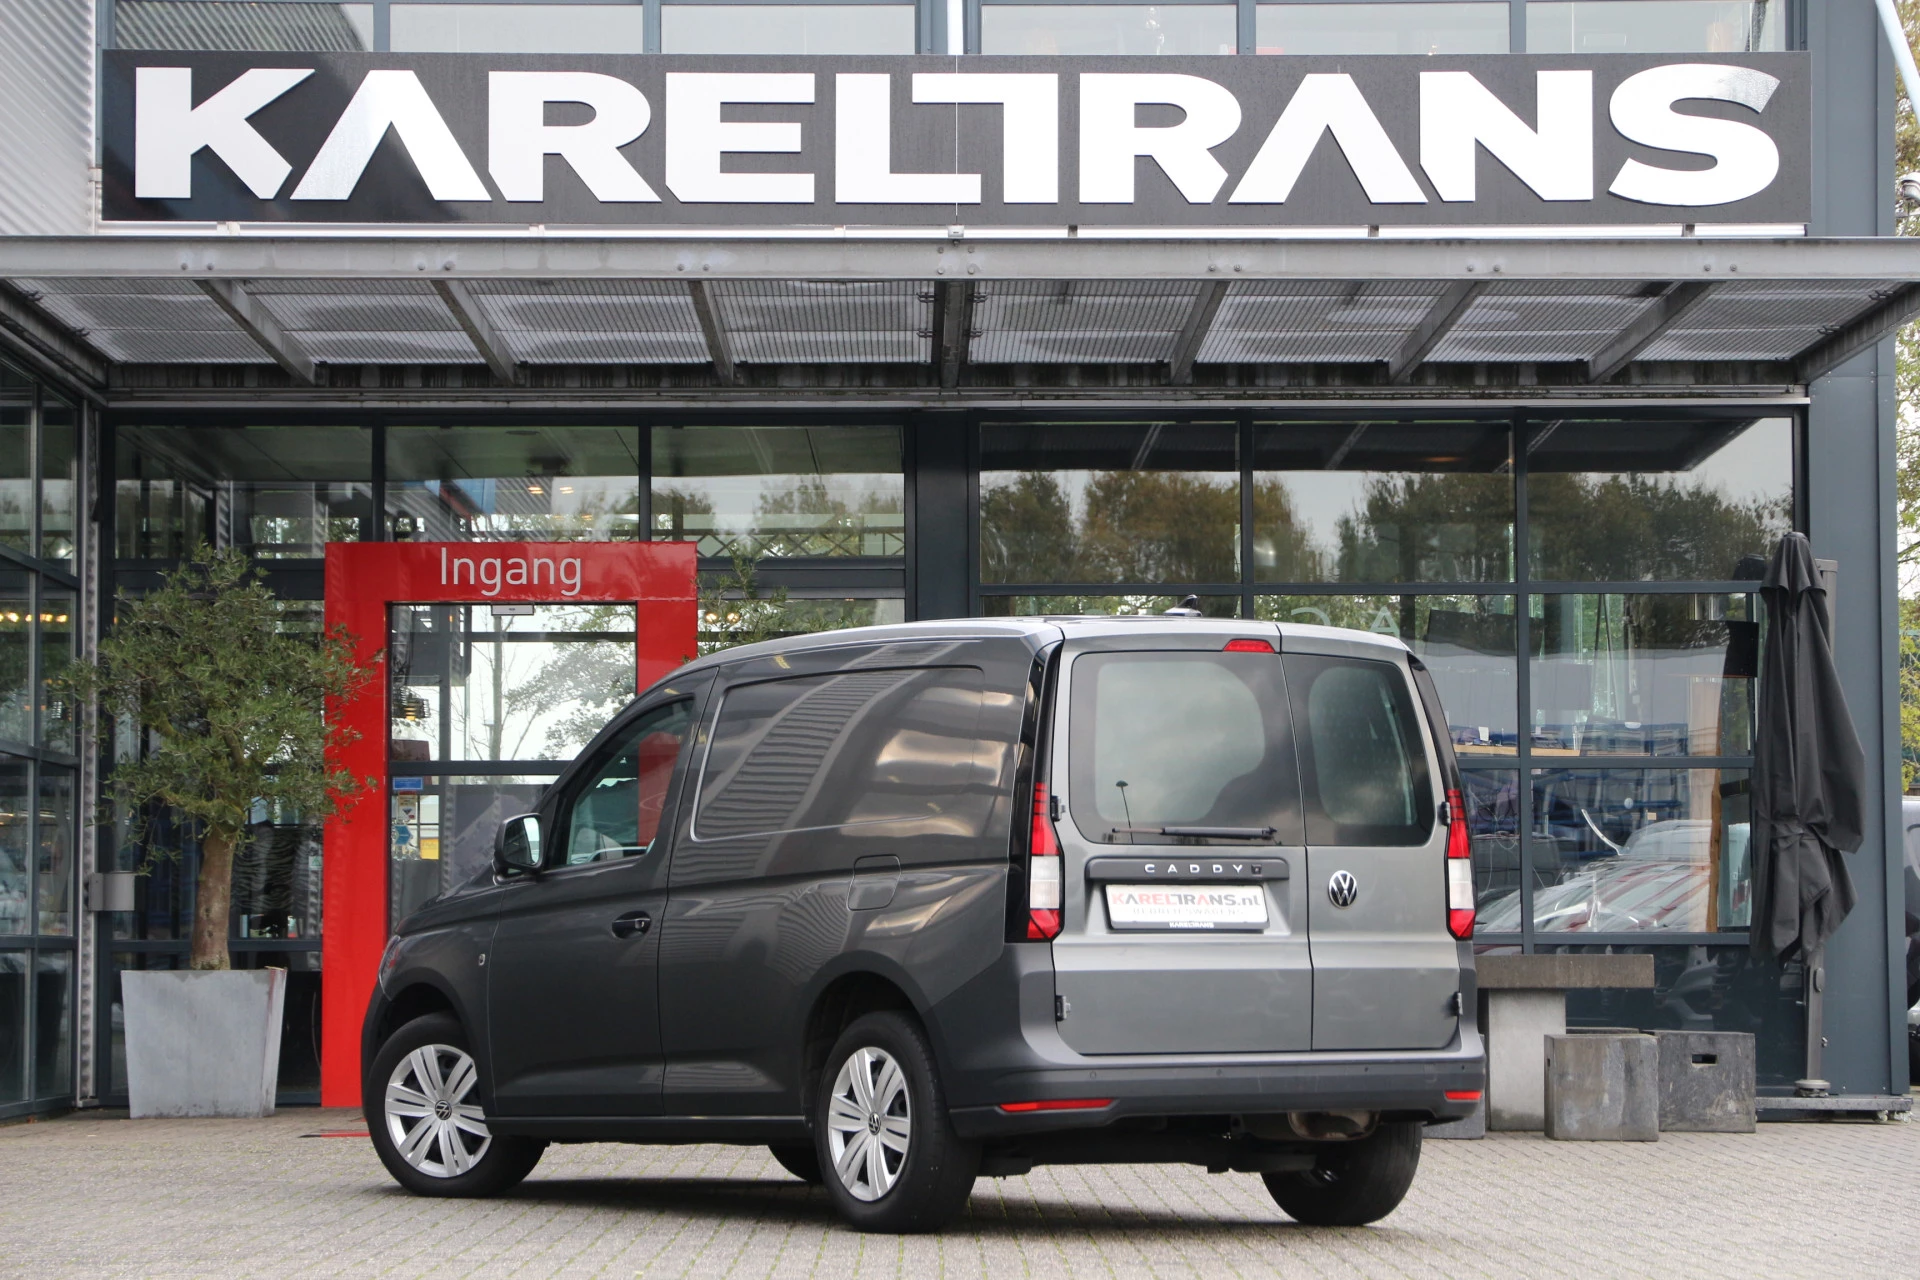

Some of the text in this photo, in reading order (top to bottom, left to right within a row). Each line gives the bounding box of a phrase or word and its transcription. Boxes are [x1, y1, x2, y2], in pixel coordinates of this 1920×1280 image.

[135, 62, 1780, 207] KARELTRANS
[441, 547, 581, 596] Ingang
[1144, 863, 1243, 873] CADDY
[1111, 892, 1261, 906] KARELTRANS.nl
